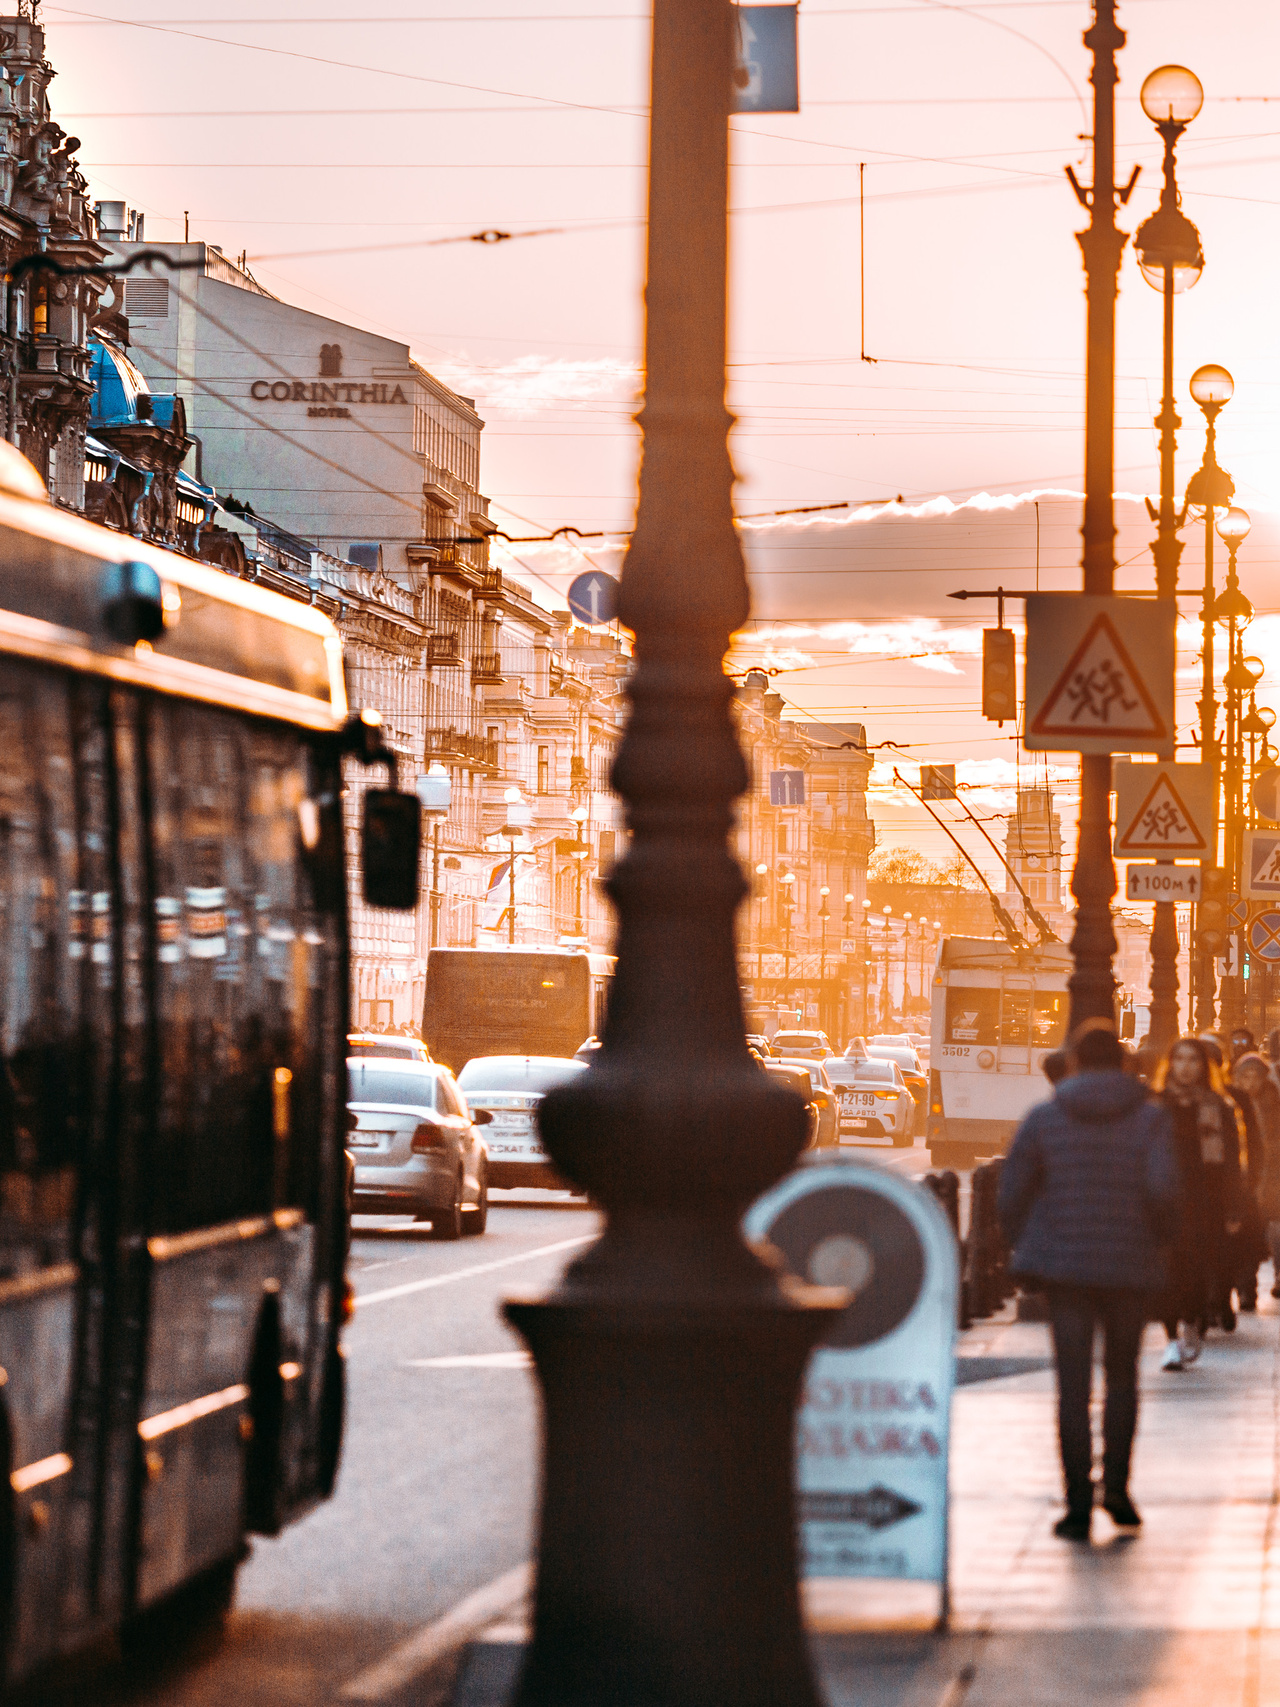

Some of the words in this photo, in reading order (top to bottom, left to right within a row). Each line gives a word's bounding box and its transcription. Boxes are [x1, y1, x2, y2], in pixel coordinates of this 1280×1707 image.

[251, 380, 408, 405] CORINTHIA
[307, 406, 351, 418] HOTEL
[1144, 875, 1184, 890] 100м
